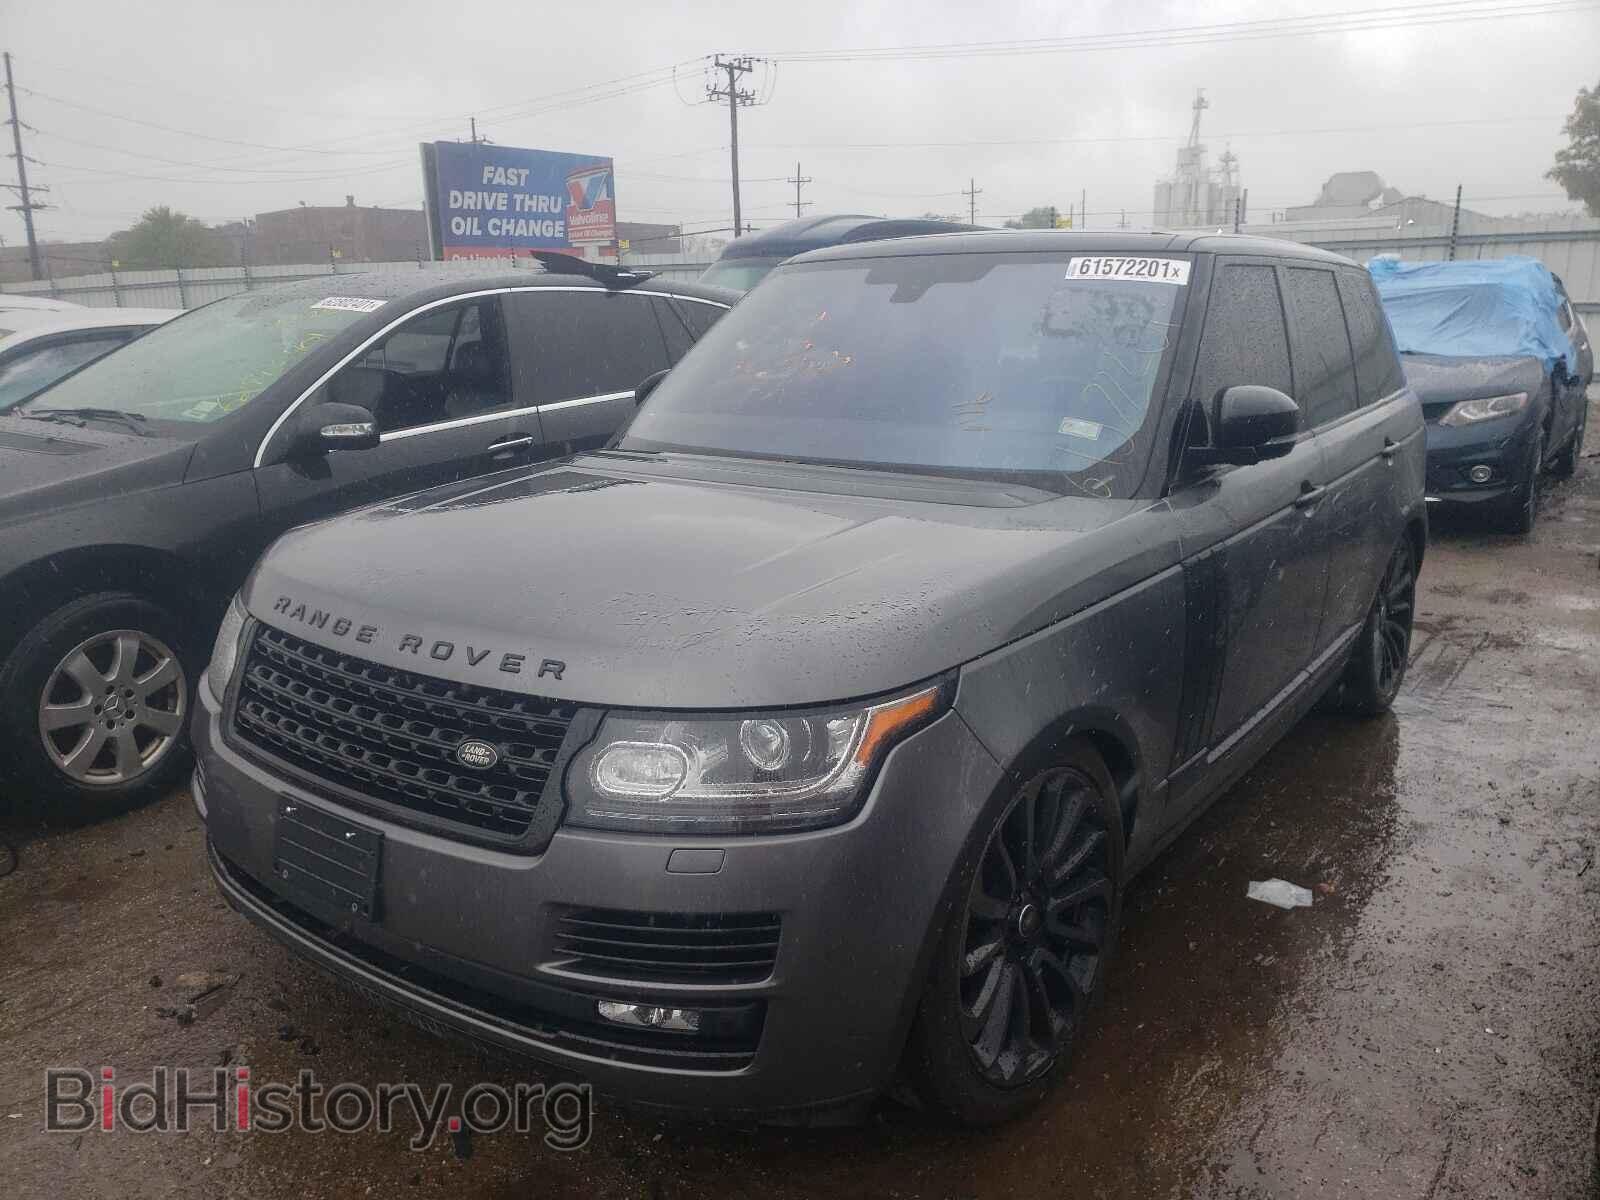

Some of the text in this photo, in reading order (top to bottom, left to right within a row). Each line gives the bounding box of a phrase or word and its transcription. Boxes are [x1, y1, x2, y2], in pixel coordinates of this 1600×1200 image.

[482, 166, 530, 187] FAST
[449, 190, 562, 214] DRIVE THRU
[451, 216, 482, 236] OIL
[487, 218, 565, 238] CHANGE
[273, 595, 567, 681] RANGE ROVER
